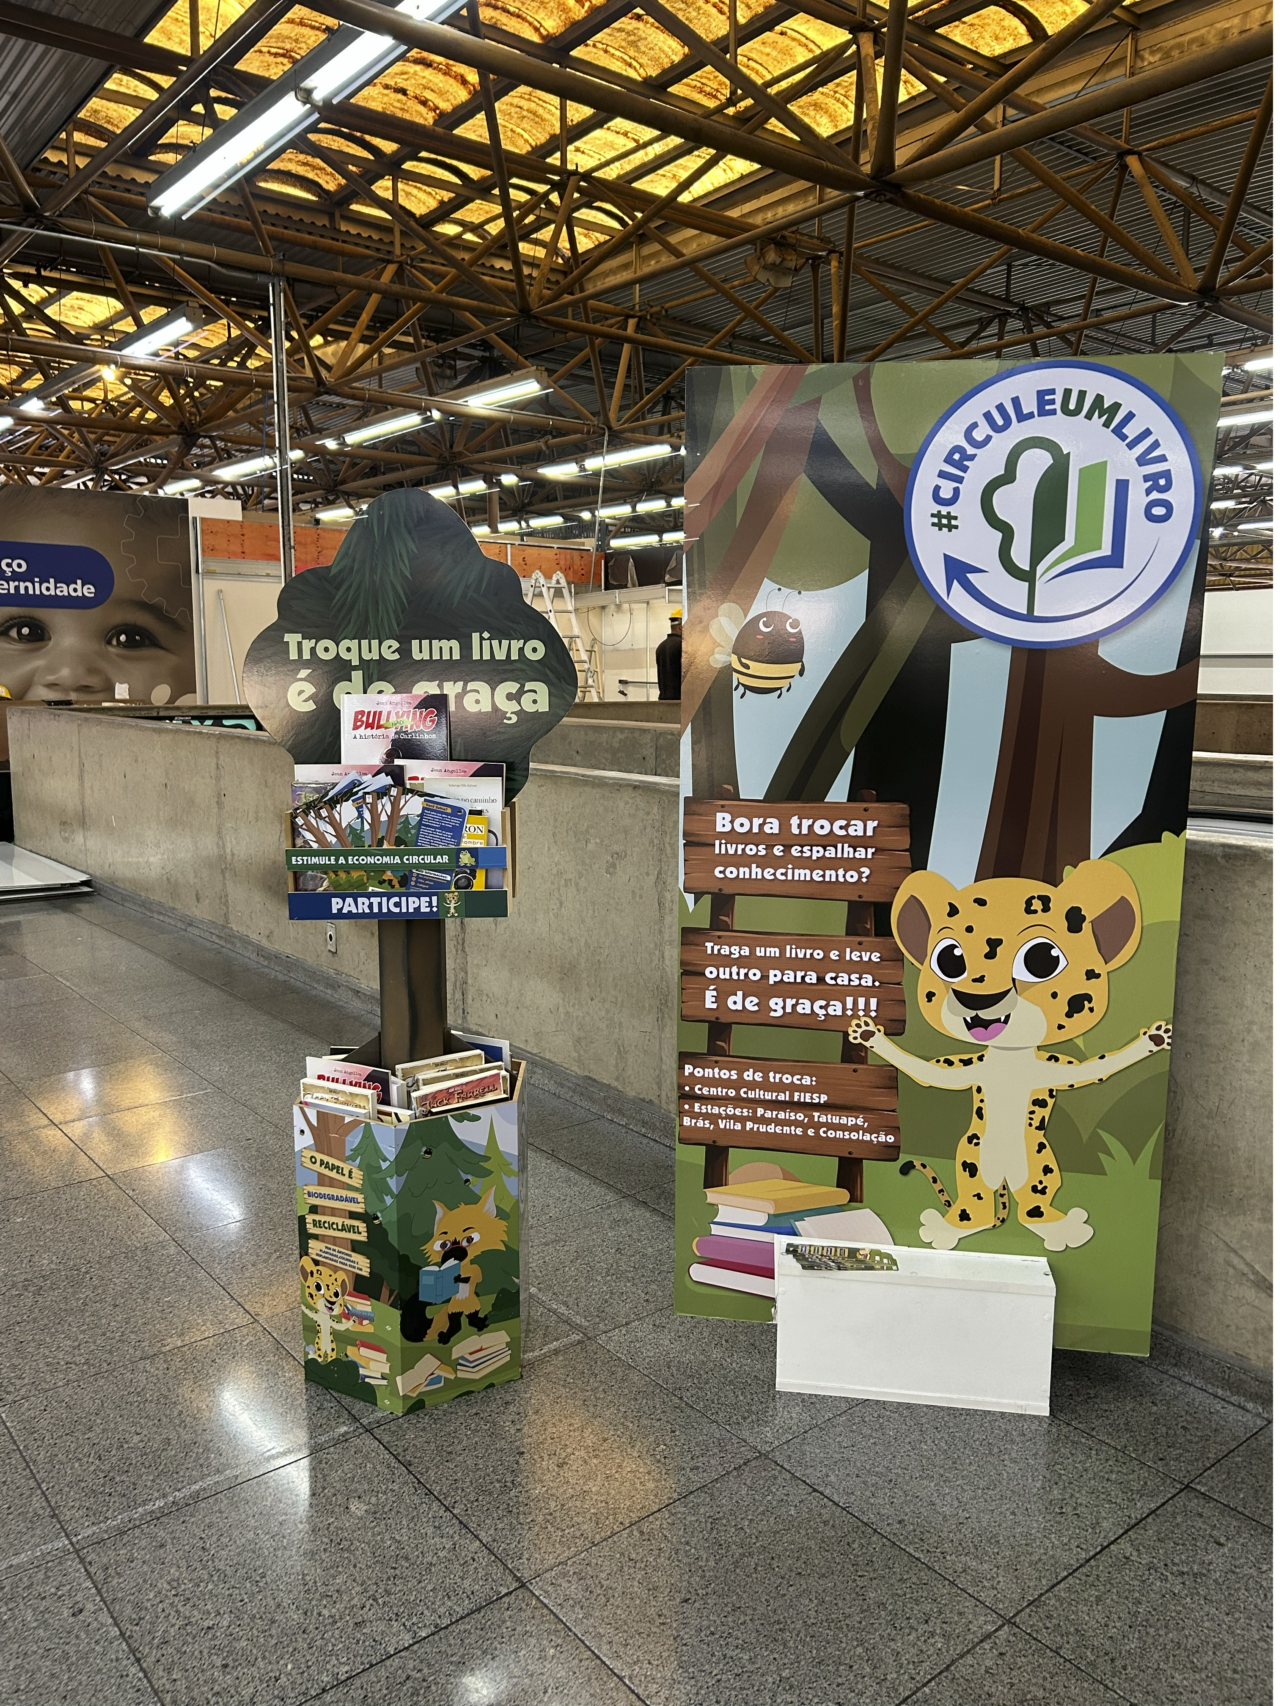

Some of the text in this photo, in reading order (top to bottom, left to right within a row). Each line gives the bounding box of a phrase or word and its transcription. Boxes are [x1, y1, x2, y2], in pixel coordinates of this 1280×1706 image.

[930, 387, 1174, 533] #CIRCULEUMLIVRO
[0, 577, 95, 597] ernidade
[283, 630, 546, 665] Troque um livro
[287, 669, 316, 712] é
[352, 708, 438, 731] BULLYING
[715, 812, 878, 836] Bora trocar
[291, 855, 449, 865] ESTIMULE A ECONOMIA CIRCULAR
[714, 839, 875, 860] livros e espalhar
[714, 863, 871, 883] conhecimento?
[331, 895, 438, 913] PARTICIPE!
[704, 942, 881, 962] Traga um livro e leve
[704, 965, 880, 987] outro para casa.
[705, 985, 878, 1021] É de graça!!!
[684, 1064, 816, 1085] Pontos de troca:
[421, 1097, 450, 1110] JACK
[453, 1084, 498, 1104] FARRELL
[694, 1085, 828, 1104] Centro Cultural FIESP
[694, 1103, 869, 1128] Estações: Paraíso, Tatuapé,
[683, 1116, 895, 1144] Brás, Vila Prudente e Consolação
[309, 1155, 353, 1179] O PAPEL É
[307, 1190, 360, 1204] BIODEGRADÁVEL
[312, 1218, 362, 1235] RECICLÁVEL
